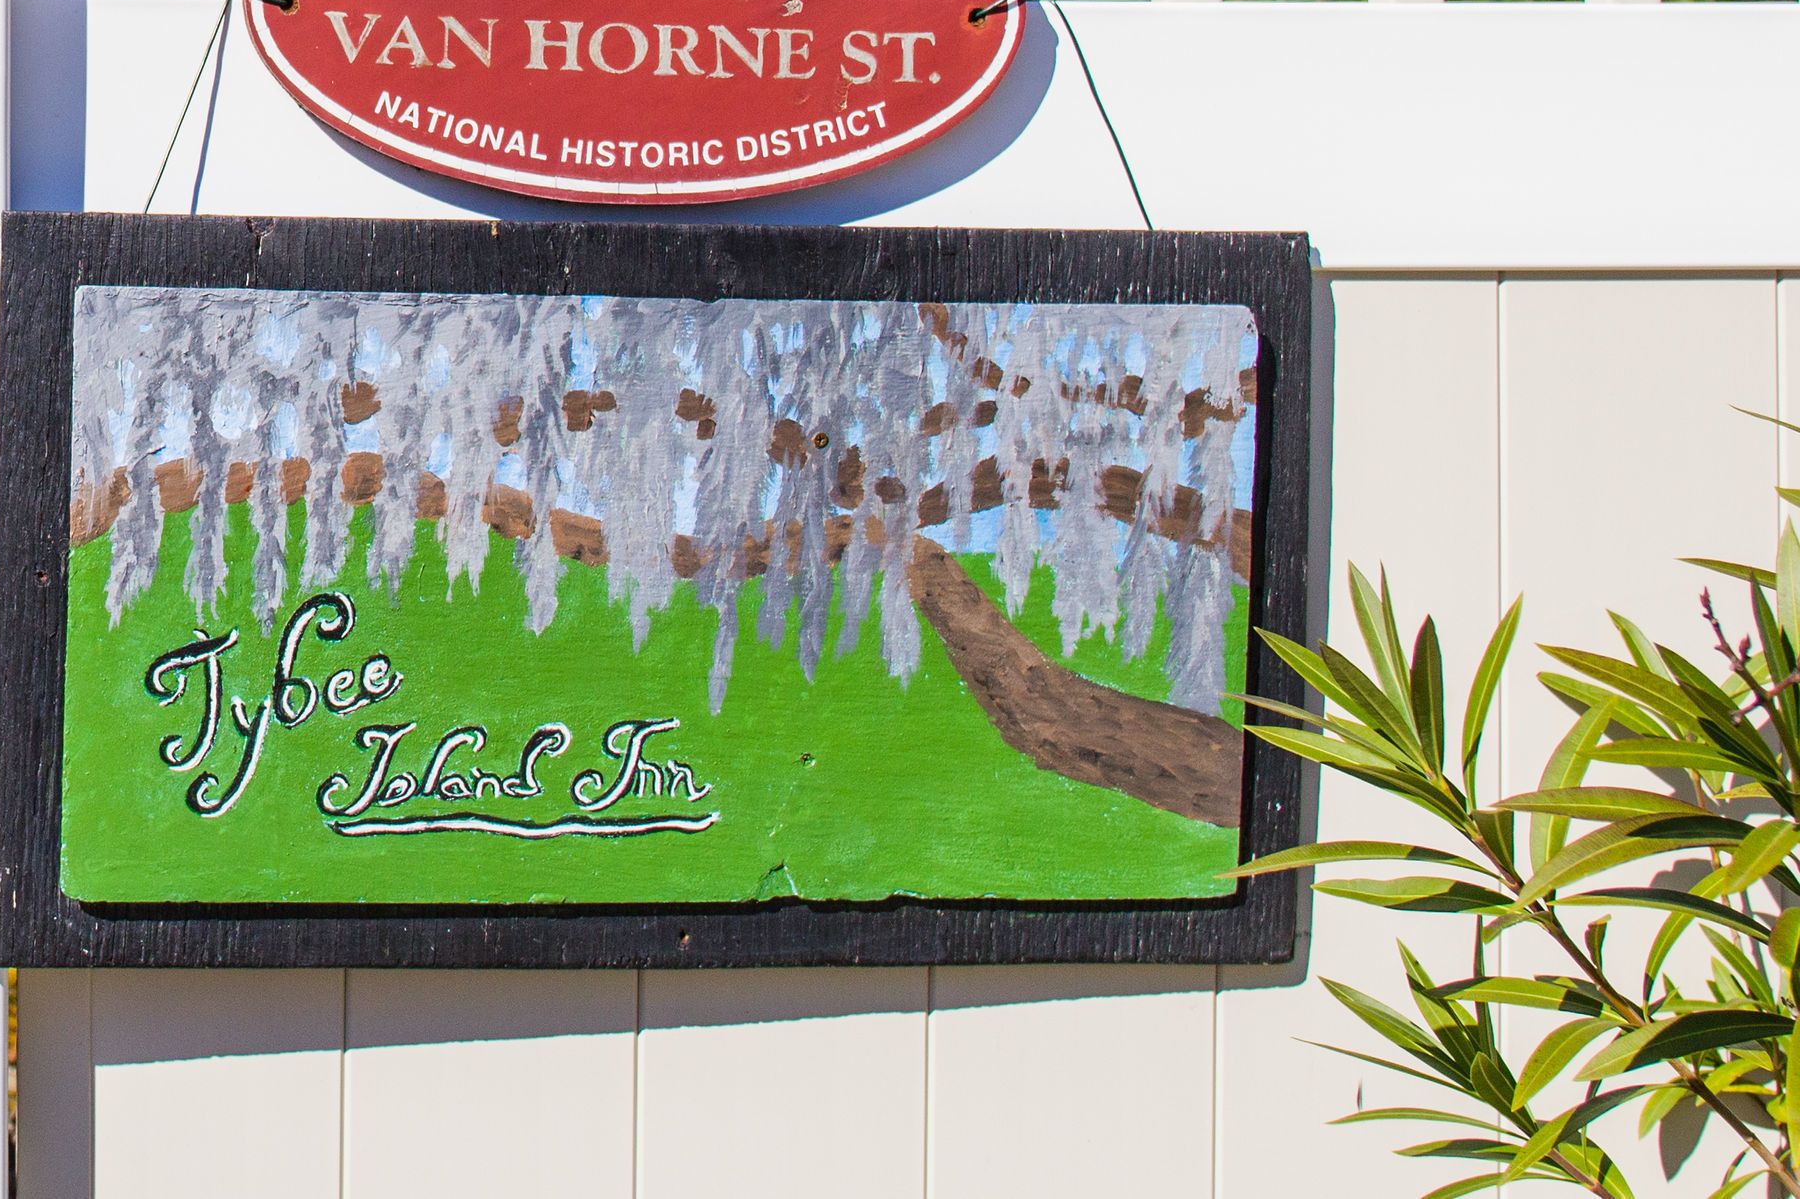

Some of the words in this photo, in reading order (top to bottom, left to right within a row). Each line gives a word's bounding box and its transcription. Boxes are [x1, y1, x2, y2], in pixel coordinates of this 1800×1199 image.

[323, 11, 499, 69] VAN
[524, 19, 816, 80] HORNE
[839, 30, 942, 85] ST.
[374, 90, 548, 161] NATIONAL
[560, 136, 726, 168] HISTORIC
[736, 101, 890, 162] DISTRICT
[144, 591, 404, 819] Tybee
[316, 721, 573, 817] Island
[569, 717, 714, 813] Inn
